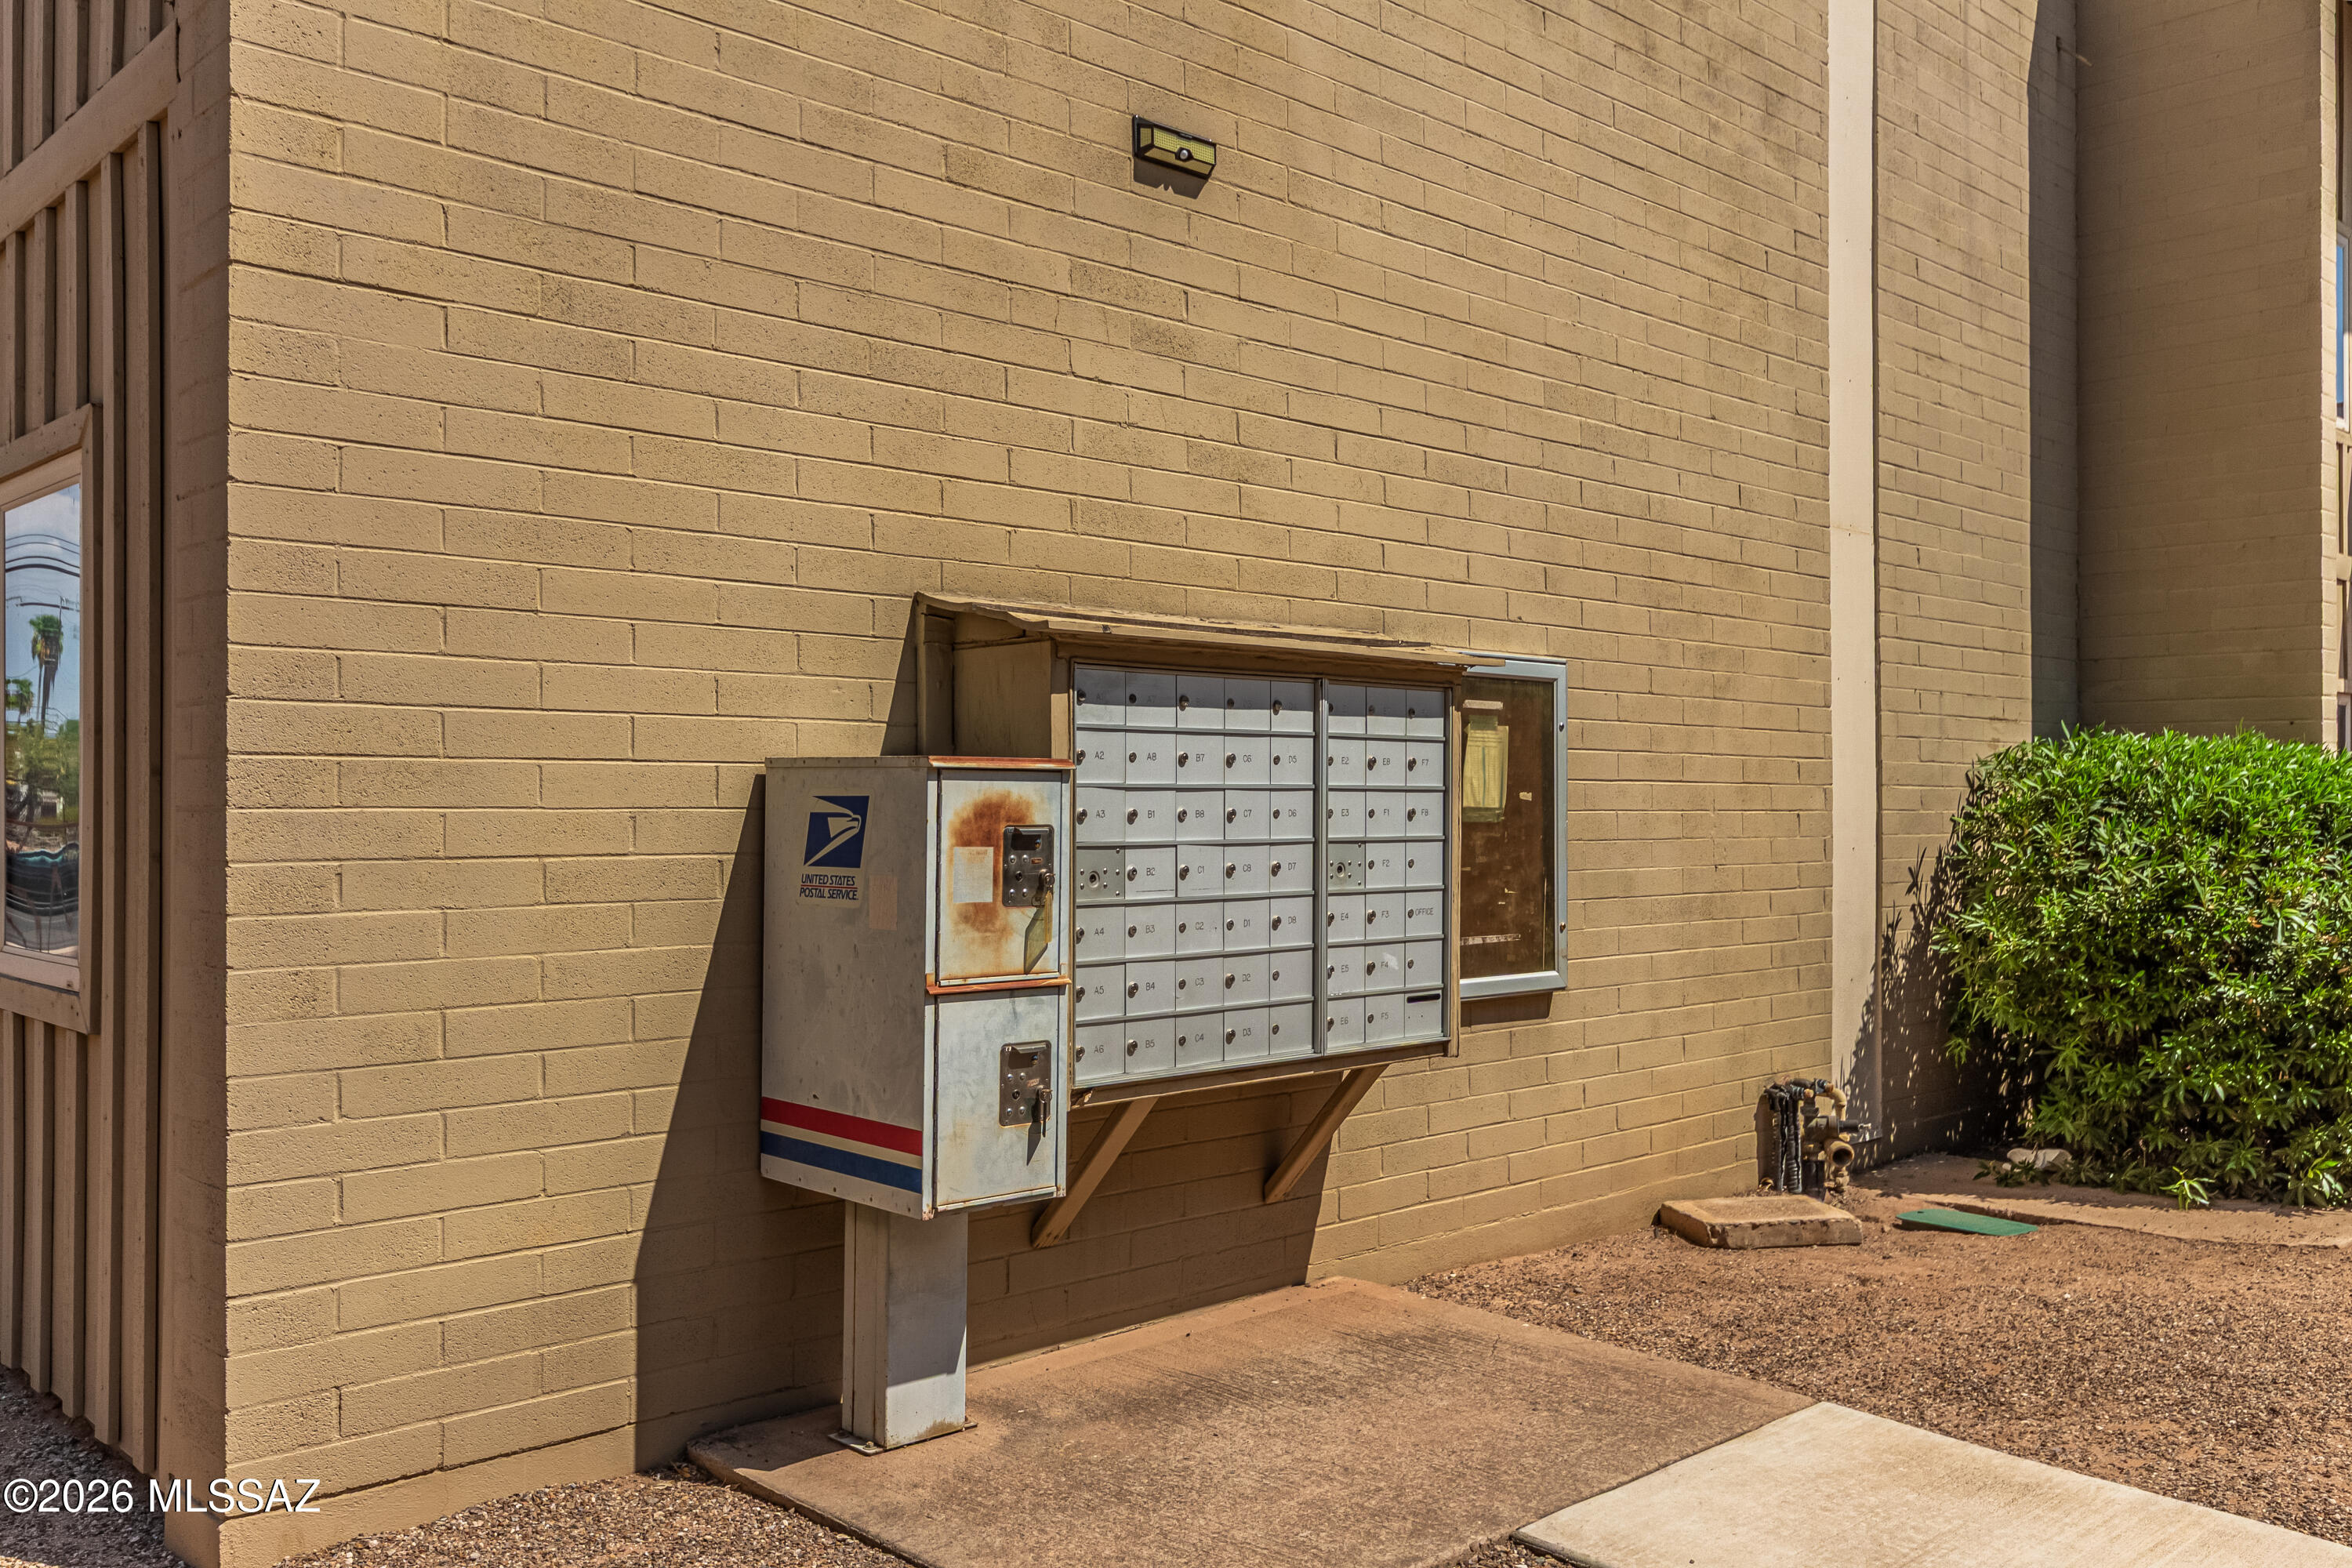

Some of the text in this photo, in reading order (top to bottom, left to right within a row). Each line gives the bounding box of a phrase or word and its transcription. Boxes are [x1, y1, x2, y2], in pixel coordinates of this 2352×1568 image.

[1094, 750, 1105, 760] A2
[1146, 752, 1157, 761] A8
[1196, 753, 1205, 762] B7
[1243, 754, 1252, 763] C6
[1288, 755, 1298, 764] D5
[1341, 757, 1349, 765] E2
[1382, 757, 1391, 766] E8
[1095, 809, 1106, 818] A3
[1147, 809, 1155, 819] B1
[1195, 809, 1205, 818] B8
[1243, 809, 1252, 818] C7
[1288, 808, 1298, 818] D6
[1341, 808, 1350, 817] E3
[1421, 808, 1429, 817] F8
[1287, 862, 1297, 871] D7
[1382, 858, 1390, 867] F2
[1146, 867, 1156, 877] B2
[1197, 866, 1205, 874] C1
[1242, 863, 1252, 873] C8
[801, 873, 855, 886] UNITED STATES
[800, 887, 858, 900] POSTAL SERVICE
[1381, 910, 1389, 919] F3
[1414, 907, 1434, 916] OFFICE
[1287, 915, 1297, 924] D8
[1341, 913, 1349, 921] E4
[1195, 921, 1204, 931] C2
[1243, 919, 1250, 928] D1
[1094, 927, 1105, 936] A4
[1145, 924, 1156, 935] B3
[1341, 964, 1349, 973] E5
[1381, 960, 1388, 969] F4
[1094, 985, 1105, 995] A5
[1145, 982, 1156, 992] B4
